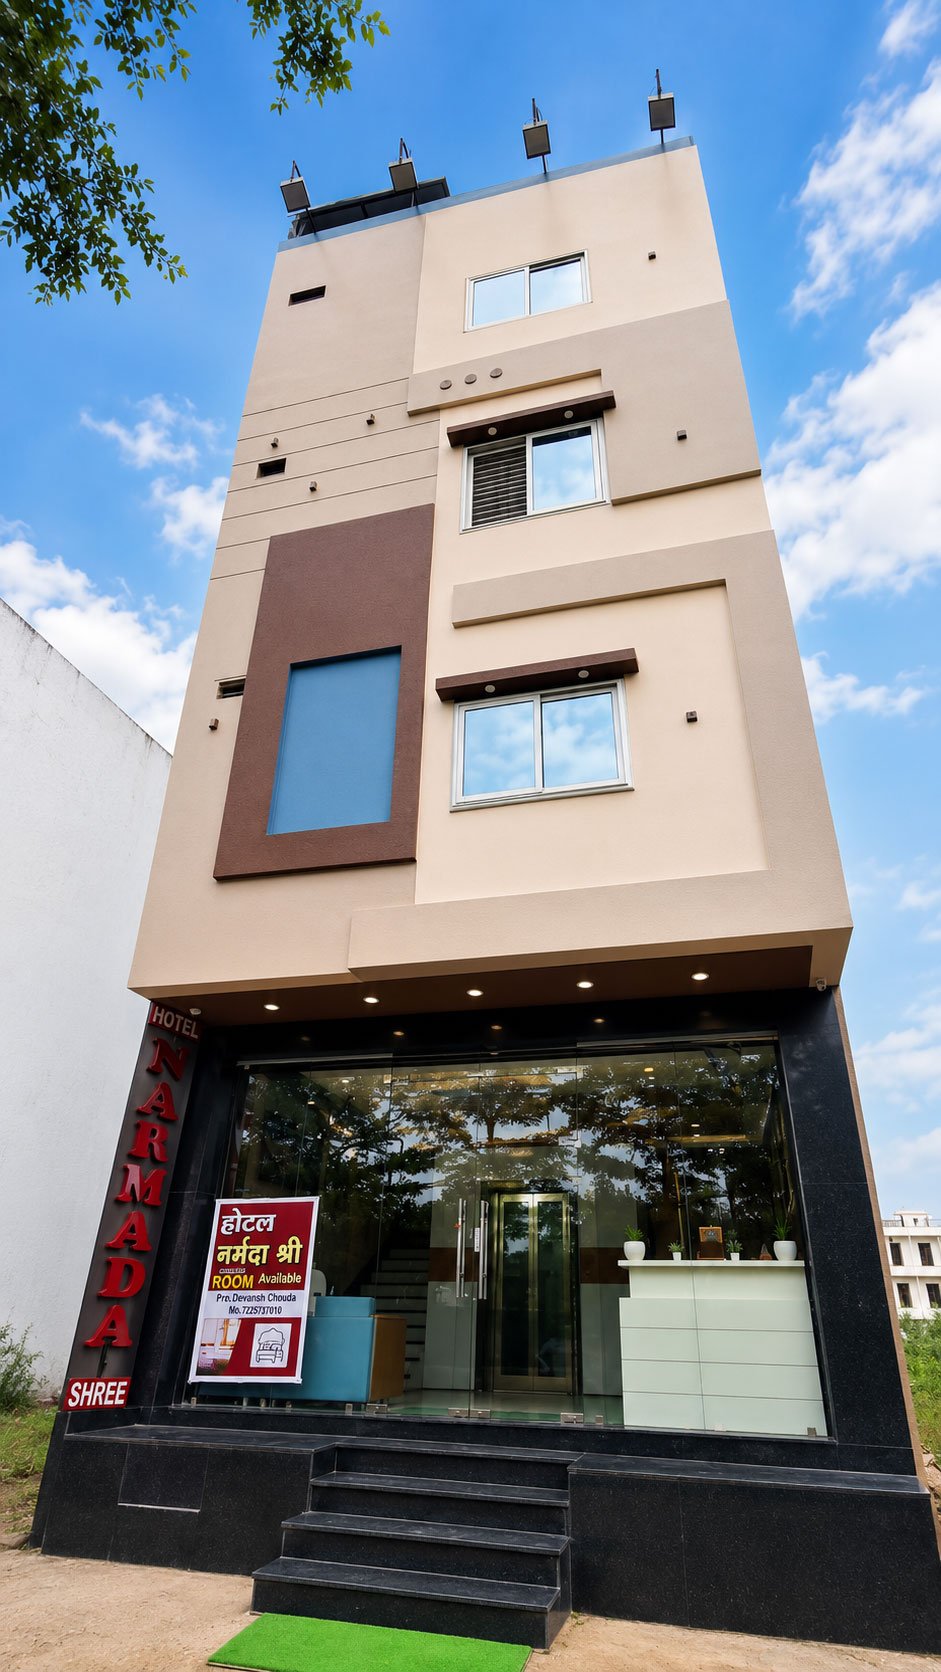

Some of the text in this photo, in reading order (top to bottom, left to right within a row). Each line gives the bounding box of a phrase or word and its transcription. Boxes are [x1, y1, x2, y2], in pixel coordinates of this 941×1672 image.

[152, 1006, 199, 1039] HOTEL
[84, 1037, 191, 1348] NARMADA
[220, 1207, 277, 1235] होटल
[217, 1235, 303, 1266] नर्मदा श्री
[212, 1272, 302, 1289] ROOM Available
[267, 1292, 297, 1302] Chouda
[67, 1381, 128, 1407] SHREE
